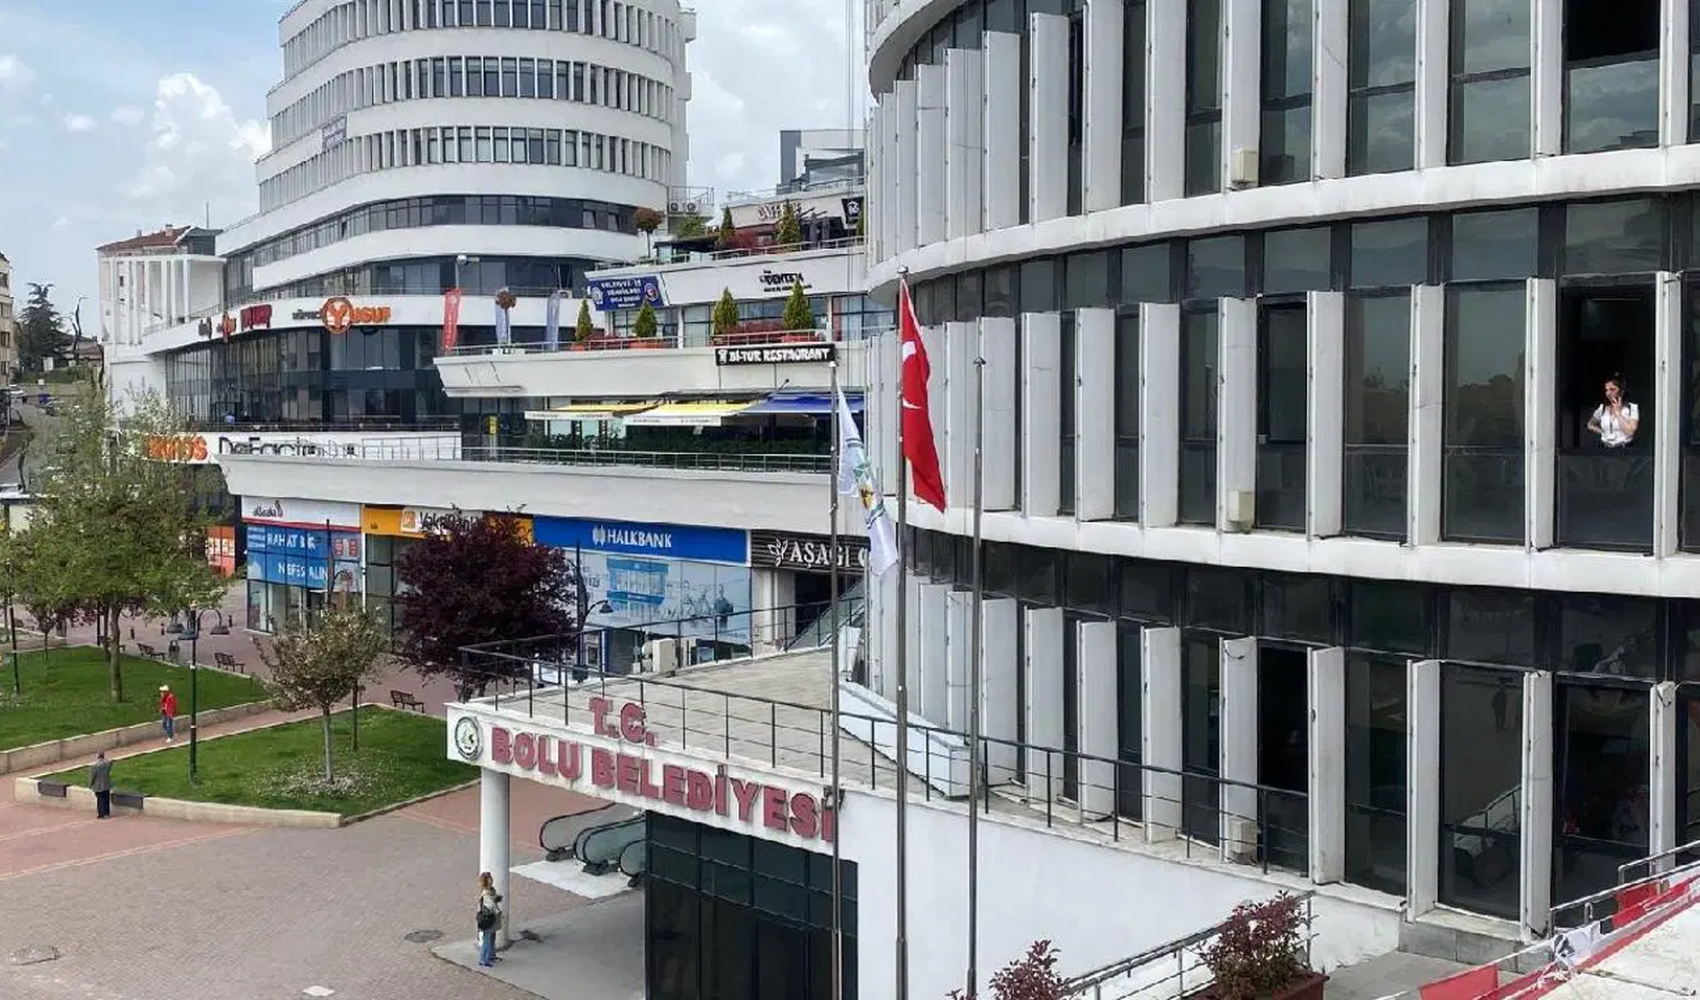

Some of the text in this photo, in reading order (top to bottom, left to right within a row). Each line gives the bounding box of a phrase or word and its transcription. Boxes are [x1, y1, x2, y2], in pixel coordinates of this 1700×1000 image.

[763, 348, 830, 362] RESTAURANT
[267, 532, 298, 548] RAHAT
[607, 528, 672, 548] HALKBANK
[278, 561, 306, 578] NEFES
[589, 697, 659, 747] T.C.
[491, 725, 838, 842] BOLU BELEDİYESİ
